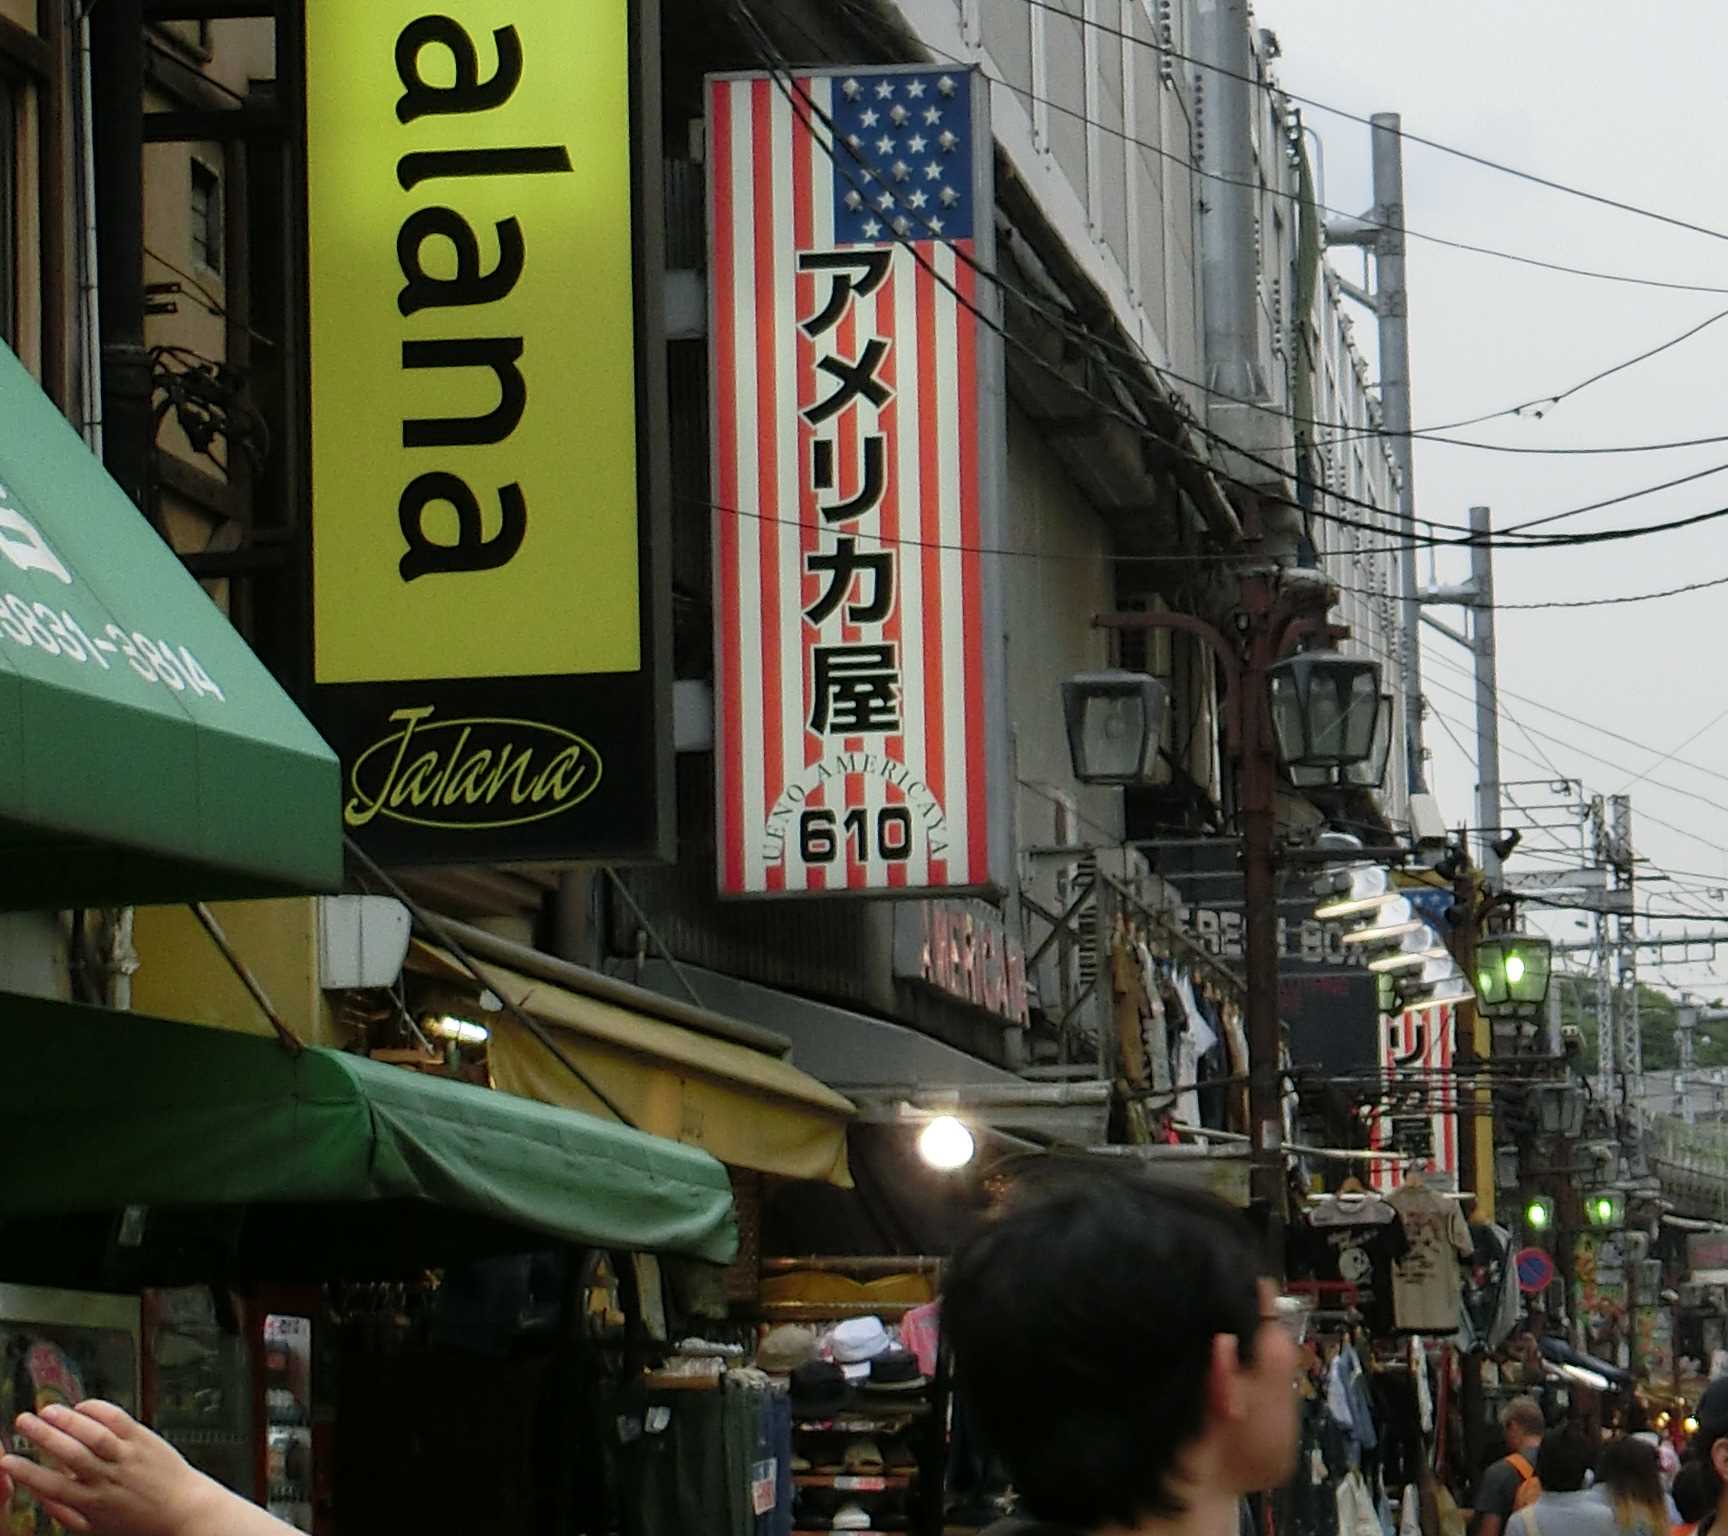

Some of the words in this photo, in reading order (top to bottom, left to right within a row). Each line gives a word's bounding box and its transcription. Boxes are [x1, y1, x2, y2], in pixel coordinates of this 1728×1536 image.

[797, 248, 901, 741] アメリカ屋
[762, 783, 806, 861] UENO
[799, 806, 913, 863] 610
